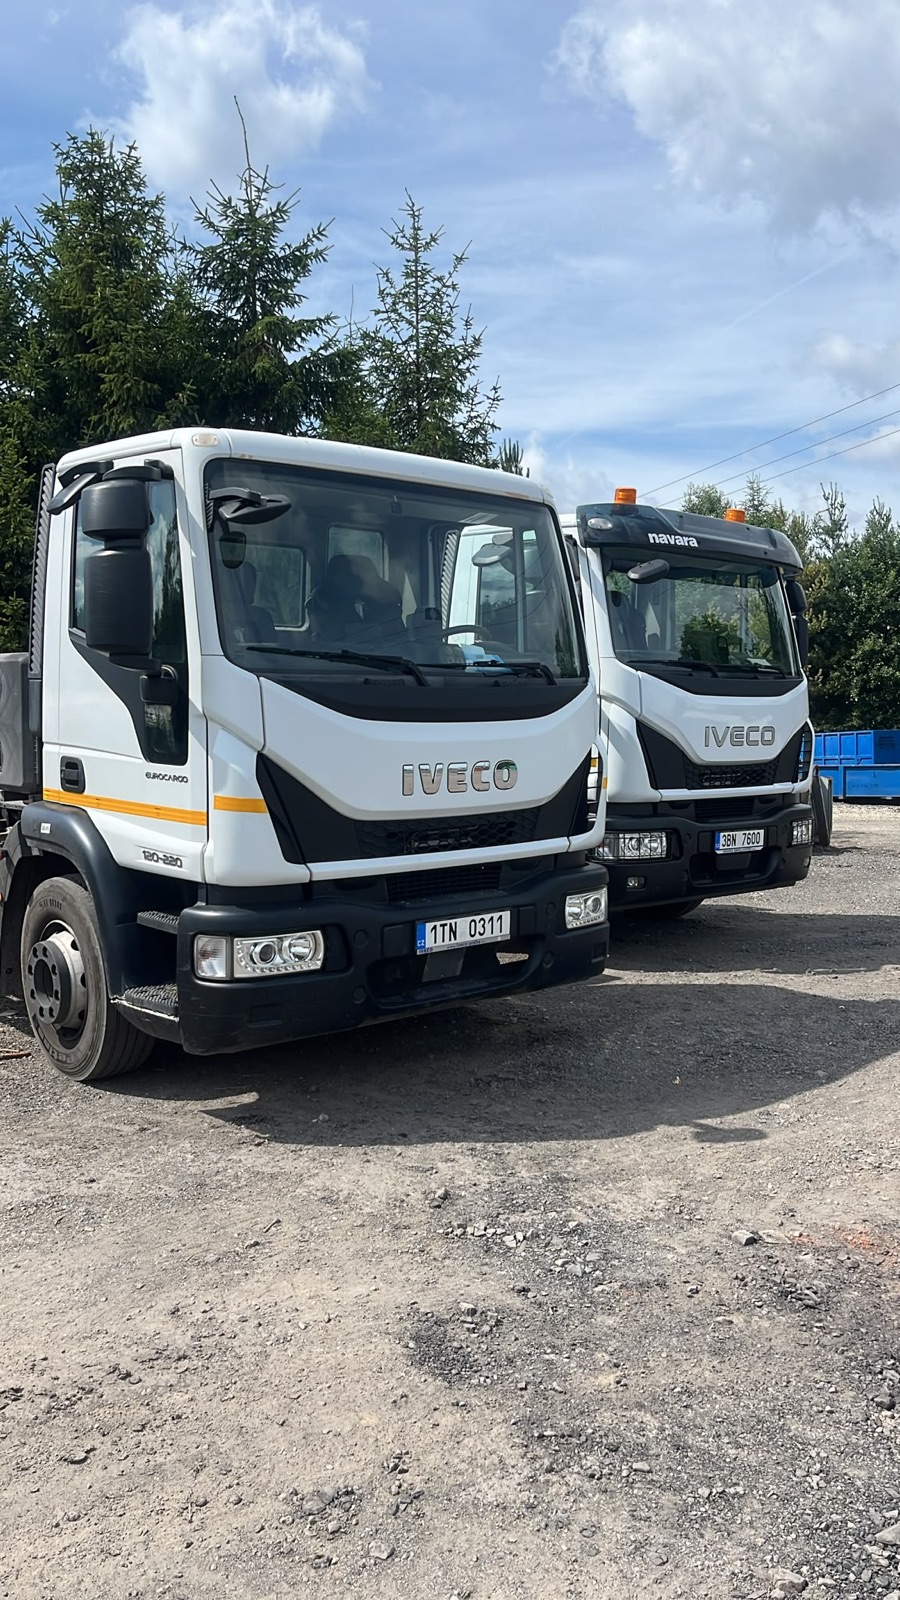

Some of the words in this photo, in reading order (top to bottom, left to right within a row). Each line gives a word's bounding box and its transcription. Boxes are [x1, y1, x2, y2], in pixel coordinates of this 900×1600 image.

[648, 532, 699, 548] navara
[704, 725, 776, 748] IVECO
[145, 771, 188, 783] EUROCARGO
[402, 759, 518, 796] IVECO
[721, 833, 737, 847] 3BN
[741, 831, 761, 846] 7600
[430, 921, 458, 945] 1TN
[469, 914, 503, 938] 0311
[417, 939, 425, 947] CZ
